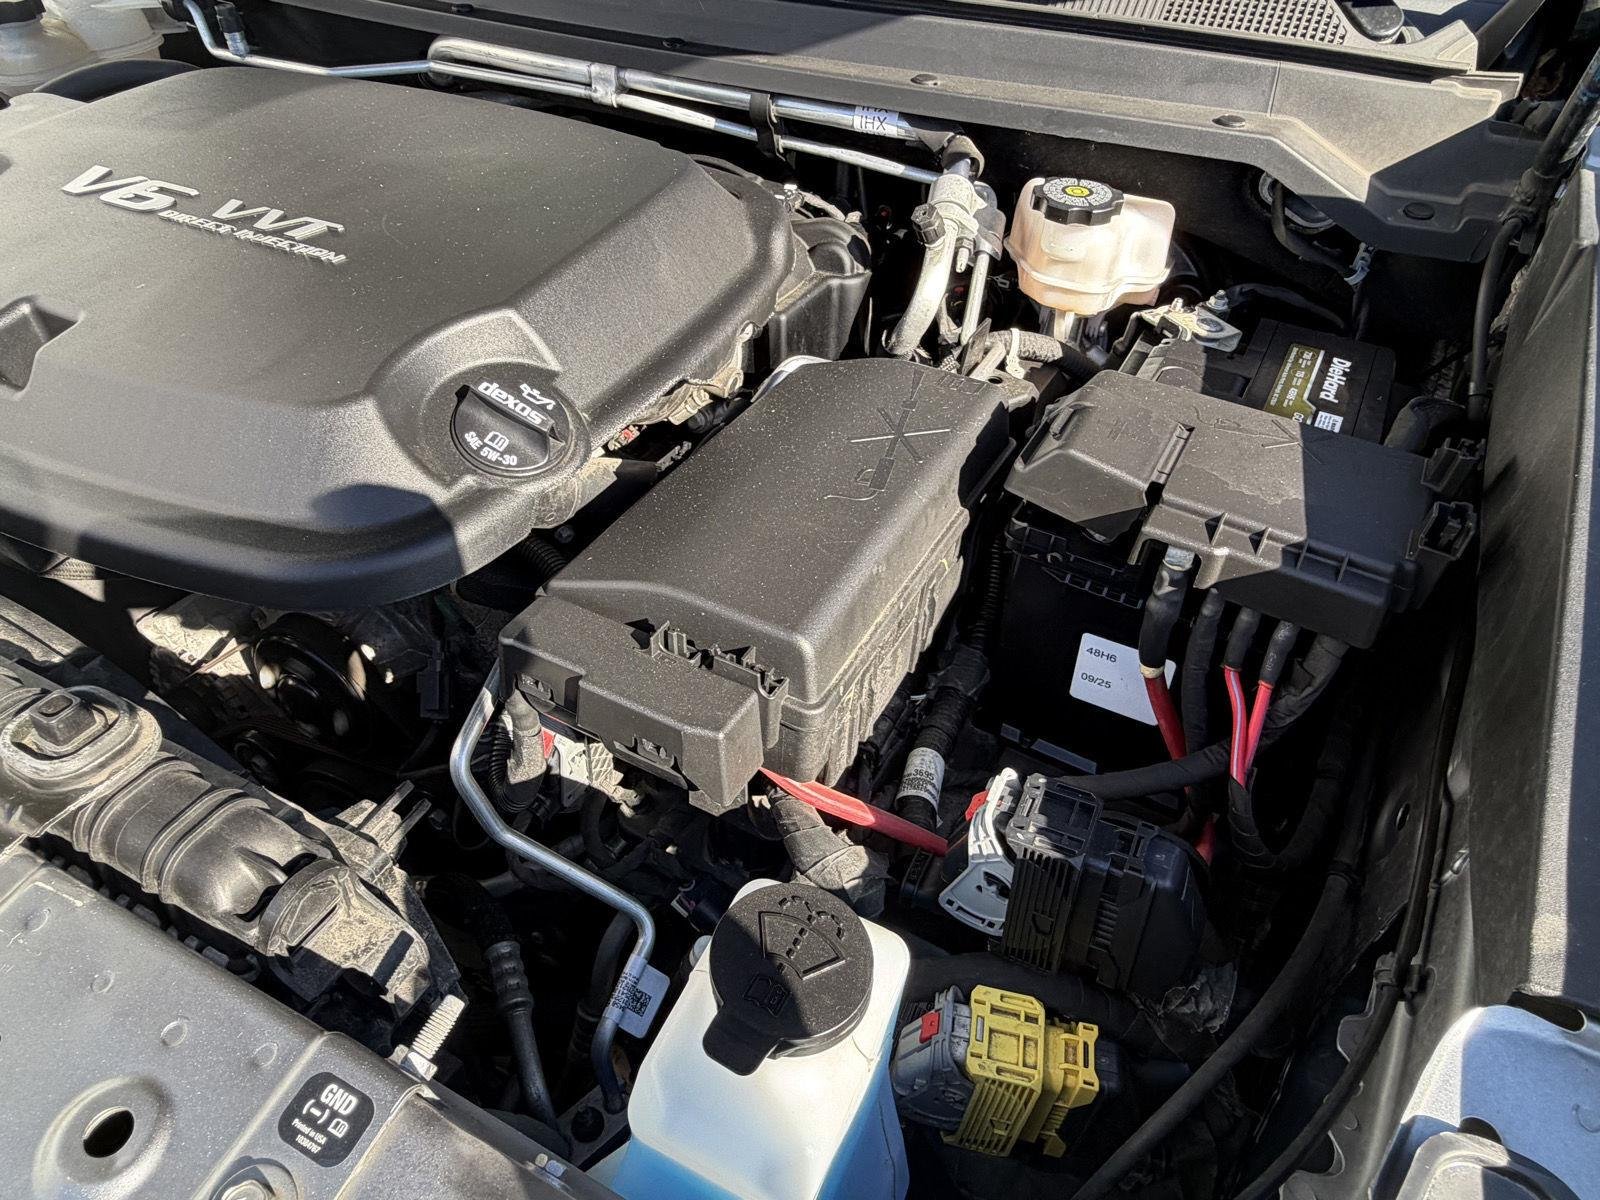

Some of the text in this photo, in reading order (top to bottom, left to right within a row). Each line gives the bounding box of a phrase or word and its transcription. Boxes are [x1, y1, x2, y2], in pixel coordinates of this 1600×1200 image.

[61, 164, 345, 241] V6 VVT
[157, 209, 347, 264] DIRECT INJECTION
[1319, 356, 1352, 404] DieHard
[477, 381, 548, 424] dexos
[464, 431, 518, 467] SAE 5W-30
[1086, 647, 1117, 663] 48H6
[1081, 672, 1112, 689] 09/25
[912, 768, 935, 781] 3695
[320, 1083, 359, 1116] GND
[291, 1118, 311, 1135] Printed
[314, 1132, 327, 1145] USA
